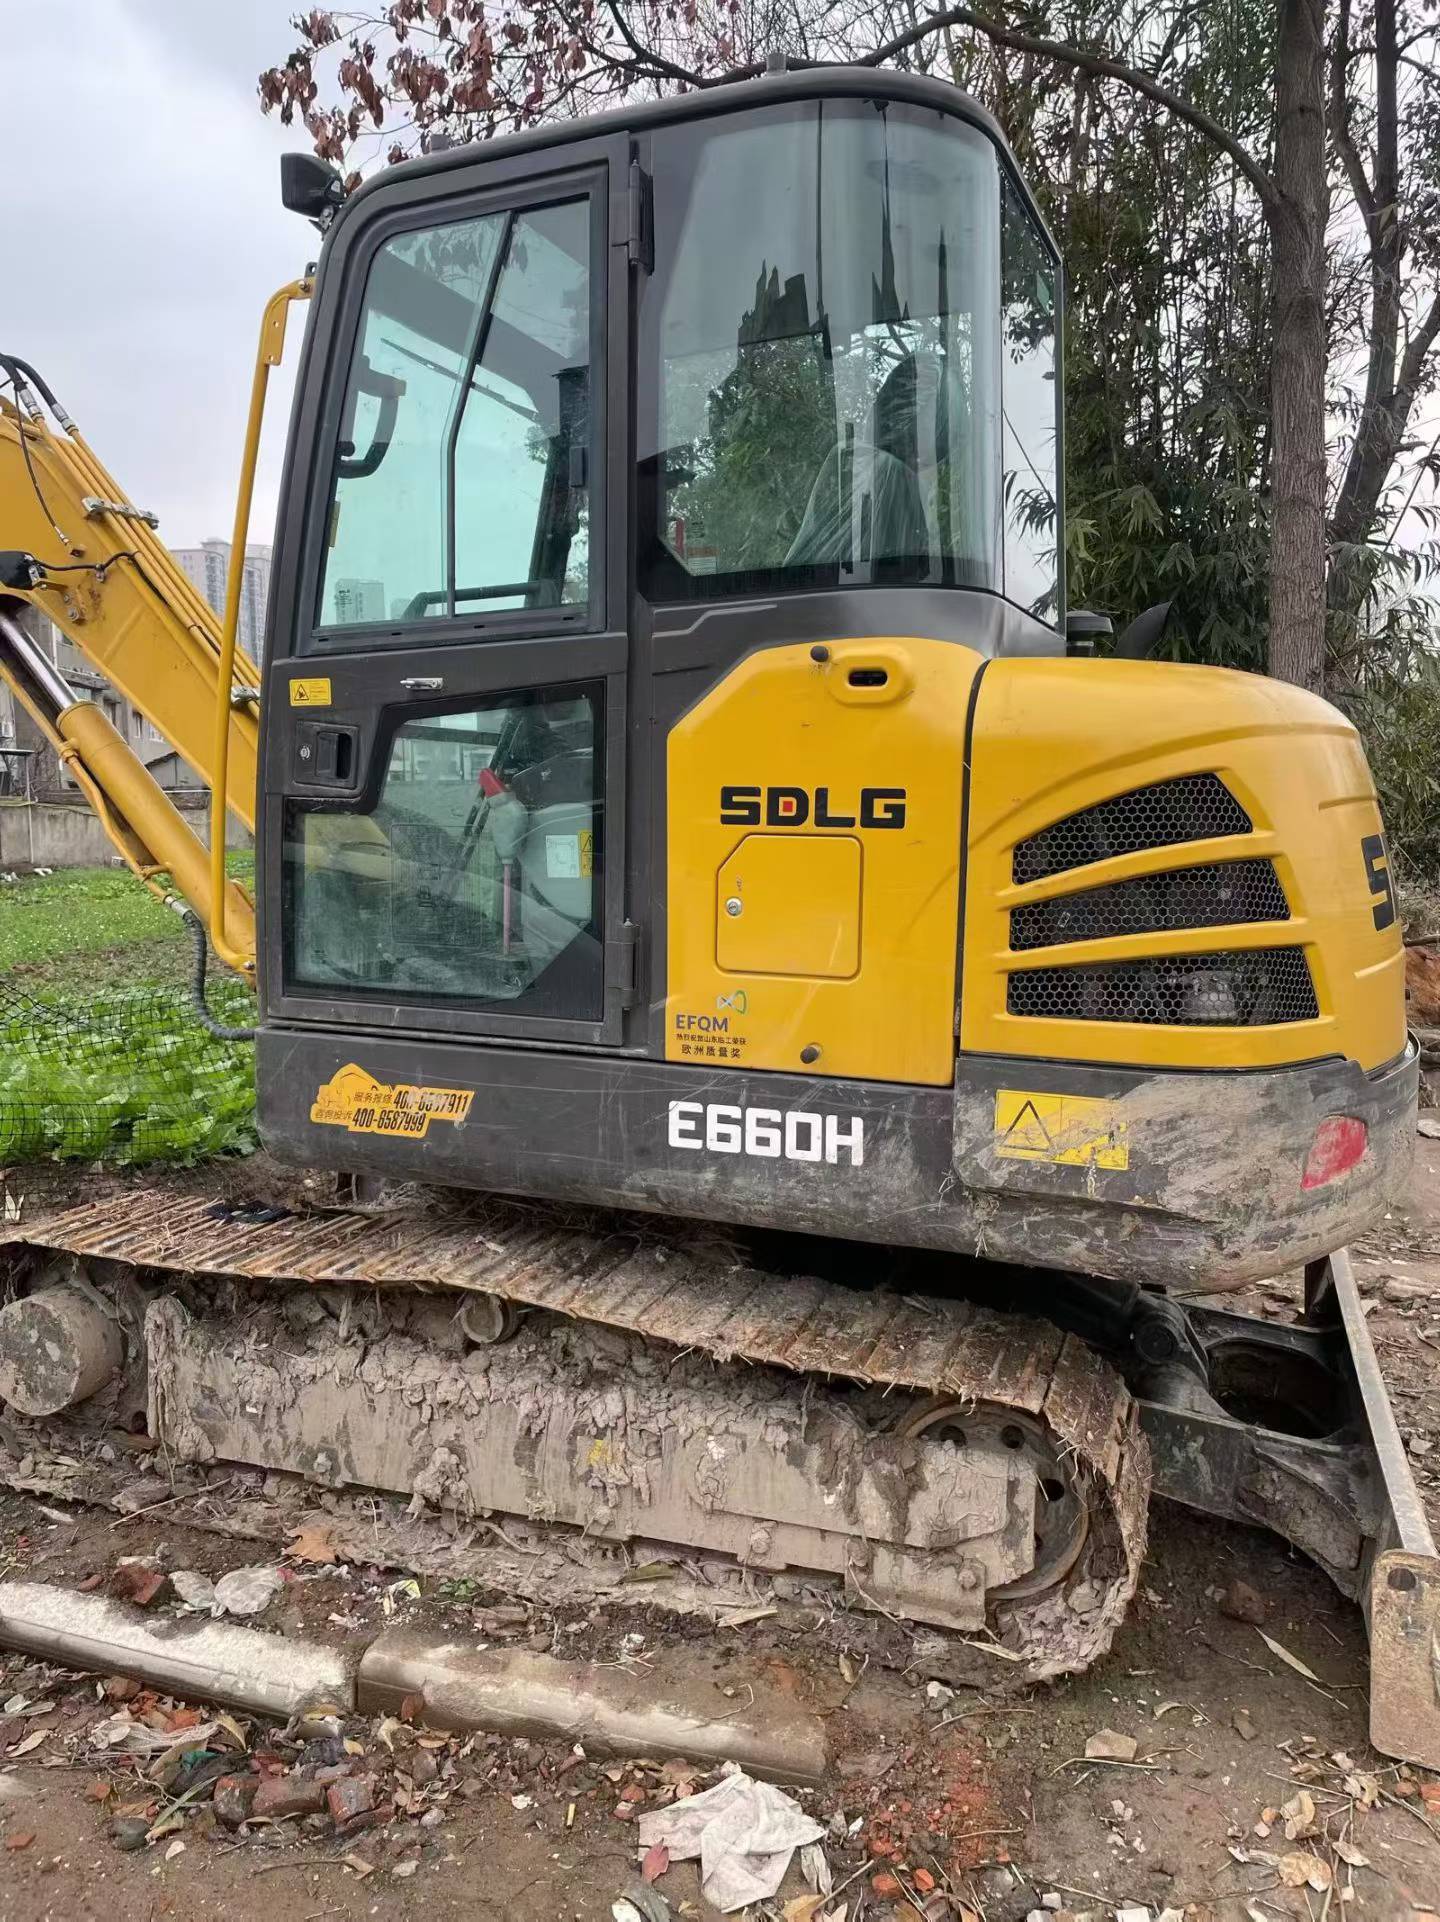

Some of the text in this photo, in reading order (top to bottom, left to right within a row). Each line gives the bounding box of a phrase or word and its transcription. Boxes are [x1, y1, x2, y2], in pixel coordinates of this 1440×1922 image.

[720, 786, 906, 829] SDLG
[676, 1014, 728, 1032] EFQM
[682, 1044, 741, 1058] 欧洲质量奖
[352, 1108, 426, 1131] 400-6587999
[668, 1100, 864, 1166] E660H
